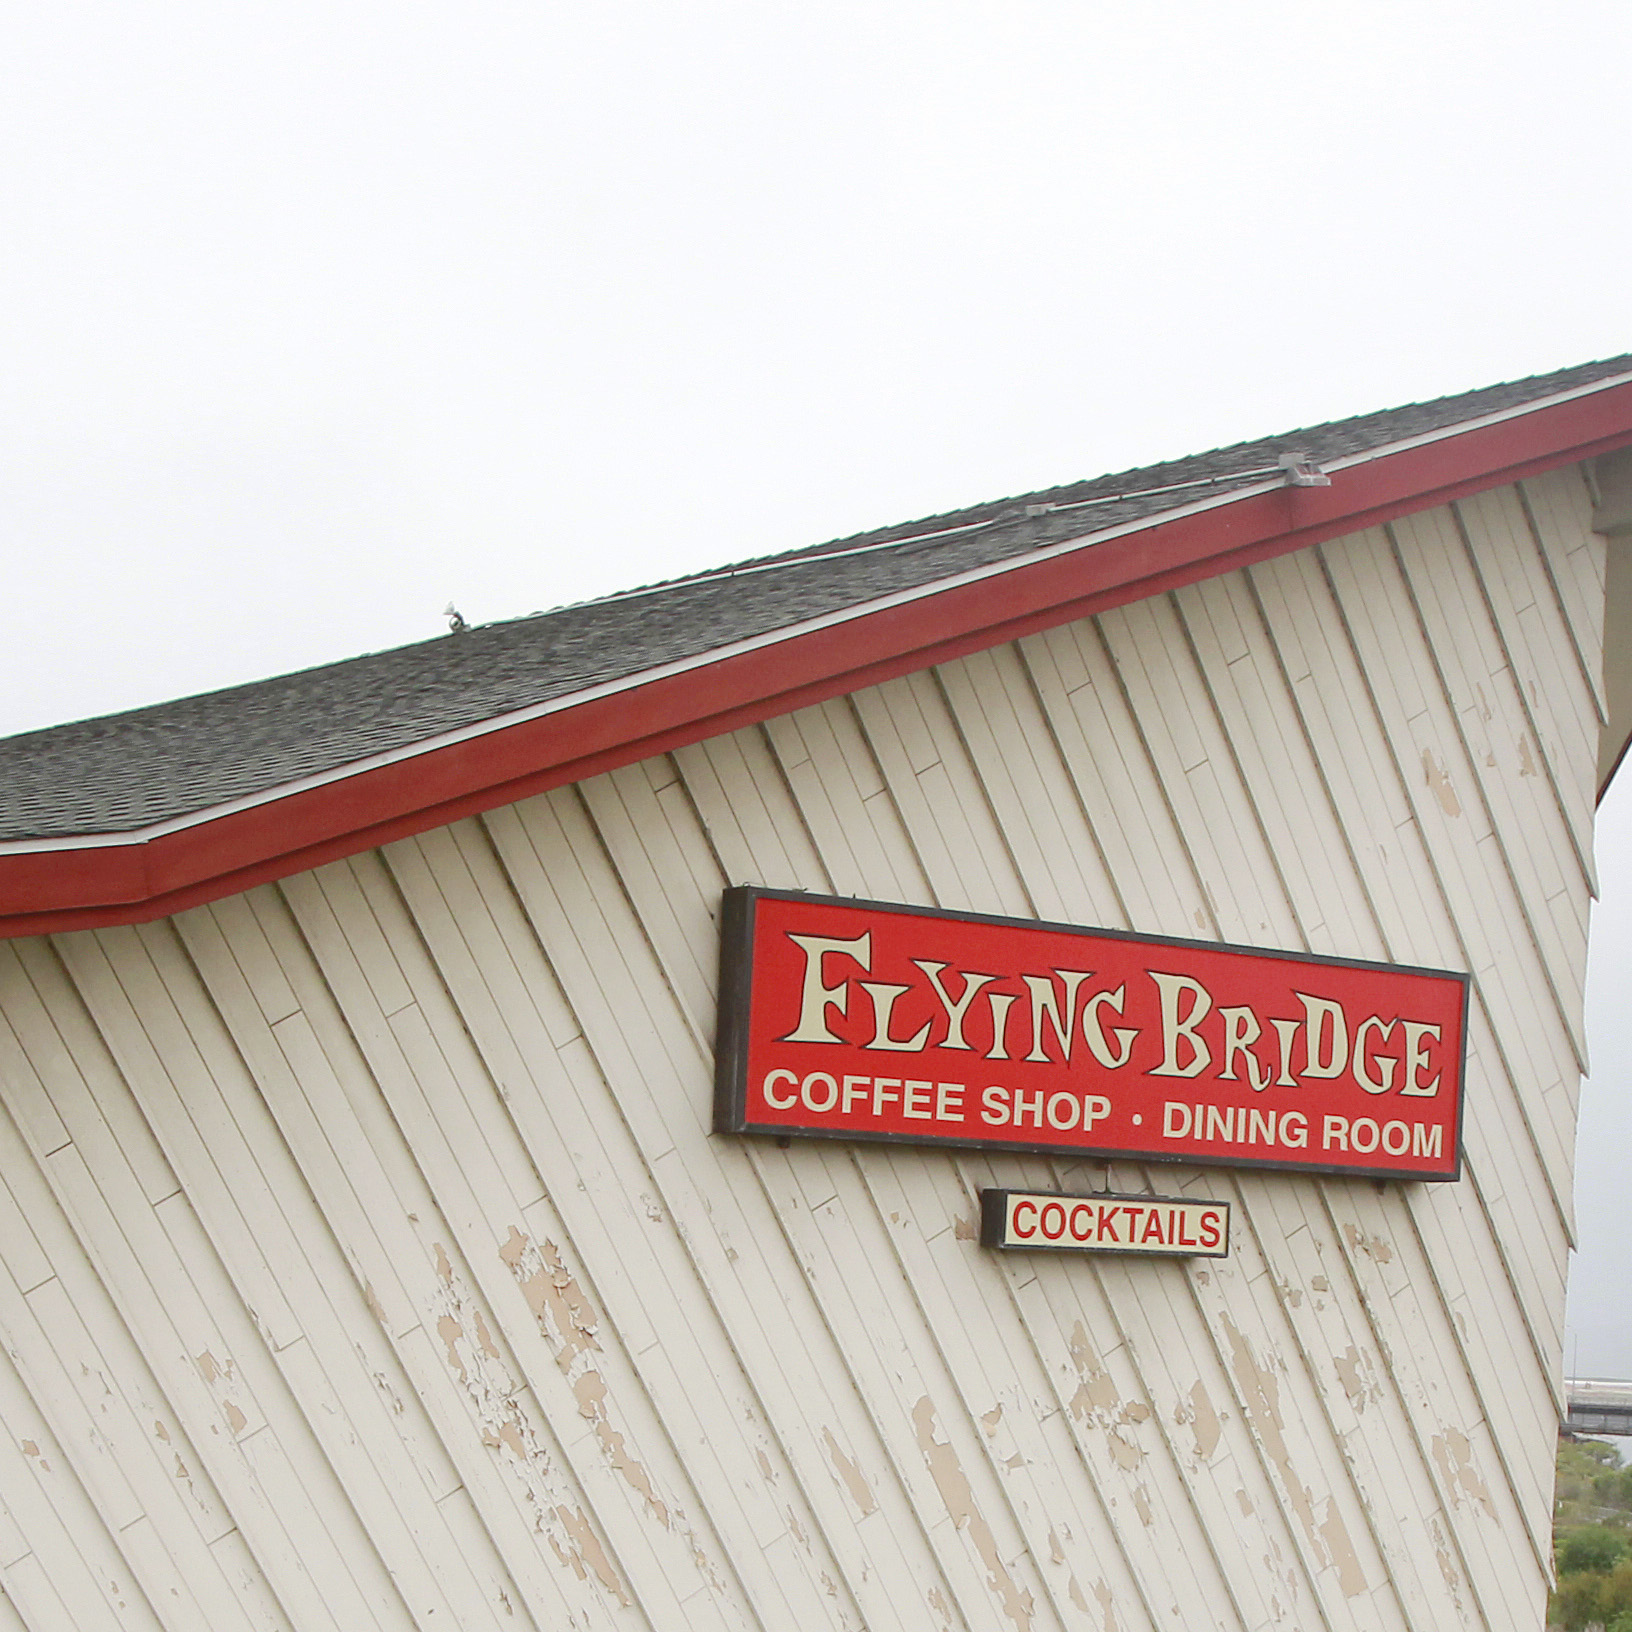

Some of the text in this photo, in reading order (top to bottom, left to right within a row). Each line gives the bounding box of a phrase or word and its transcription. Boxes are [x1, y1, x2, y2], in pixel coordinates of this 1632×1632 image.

[774, 930, 1443, 1098] FLYING BRIDGE
[763, 1069, 1443, 1159] COFFEE SHOP DINING ROOM
[1011, 1201, 1221, 1248] COCKTAILS
